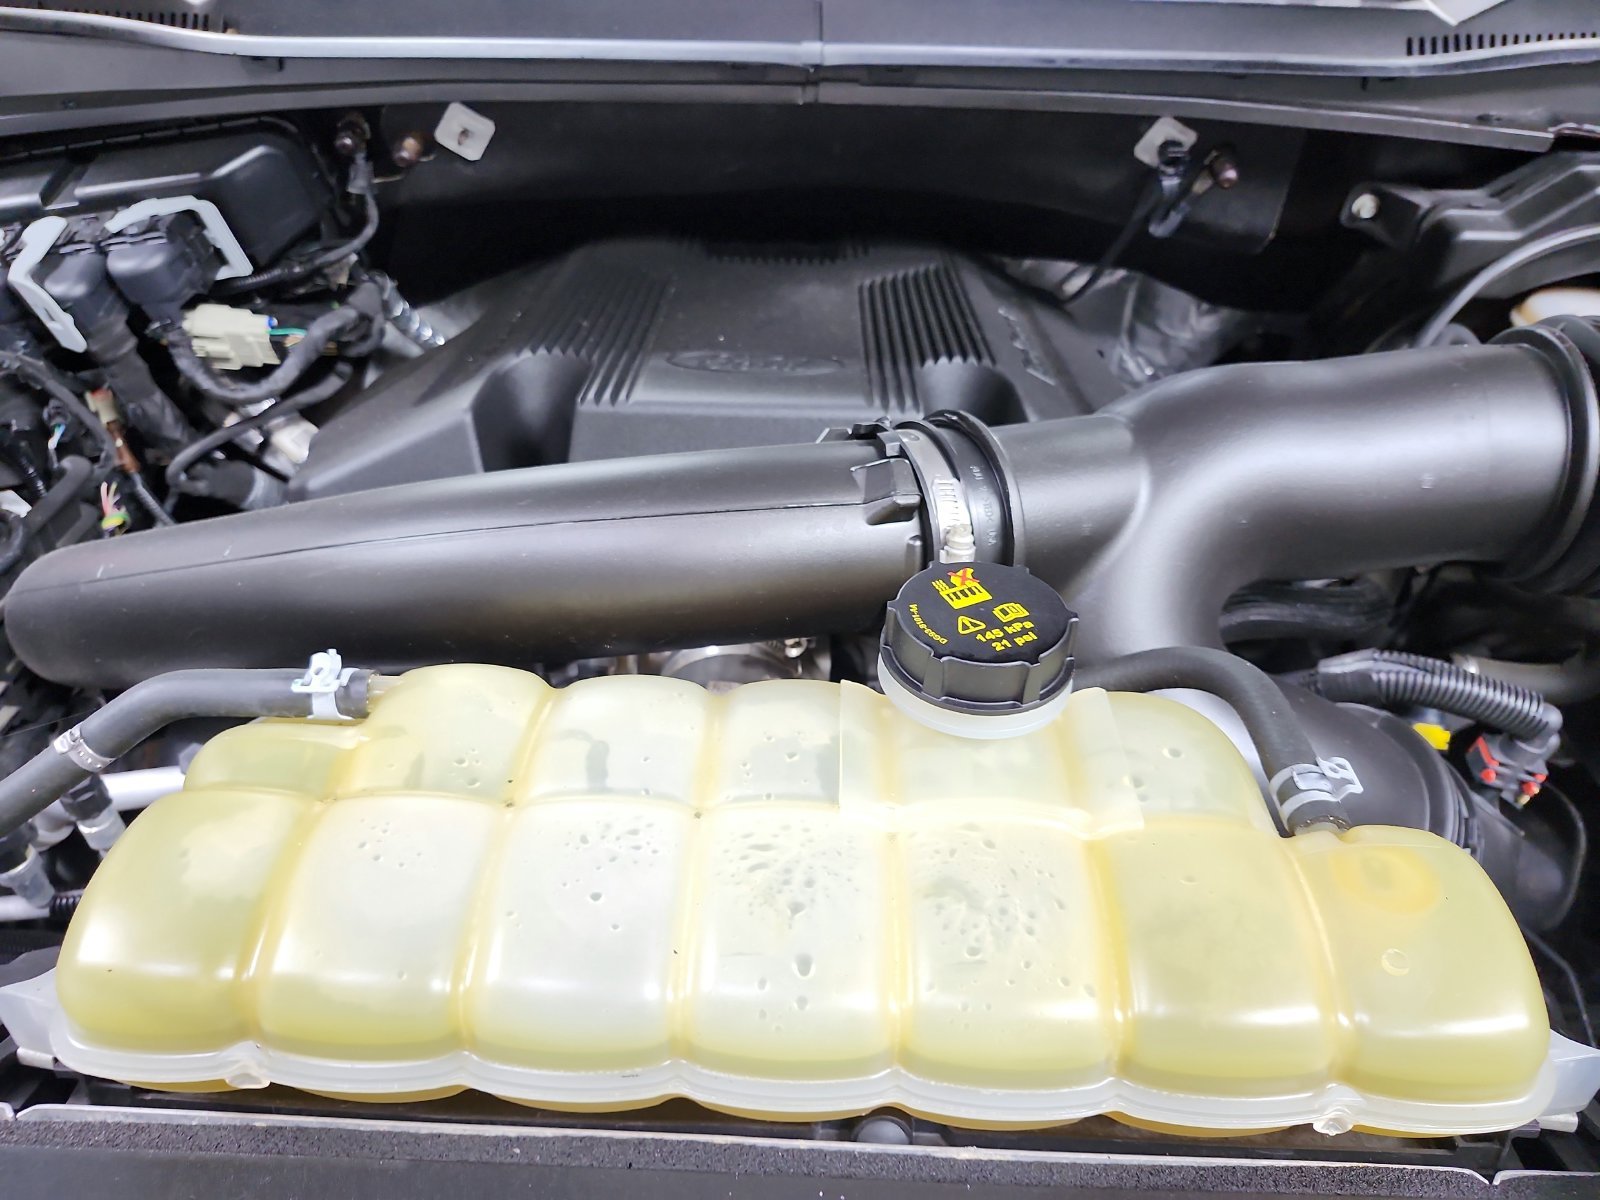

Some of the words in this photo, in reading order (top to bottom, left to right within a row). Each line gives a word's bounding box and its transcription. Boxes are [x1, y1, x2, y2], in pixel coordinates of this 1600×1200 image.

[975, 629, 1004, 642] 145
[1003, 621, 1035, 634] kPa
[991, 640, 1012, 652] 21
[1014, 632, 1038, 646] psi
